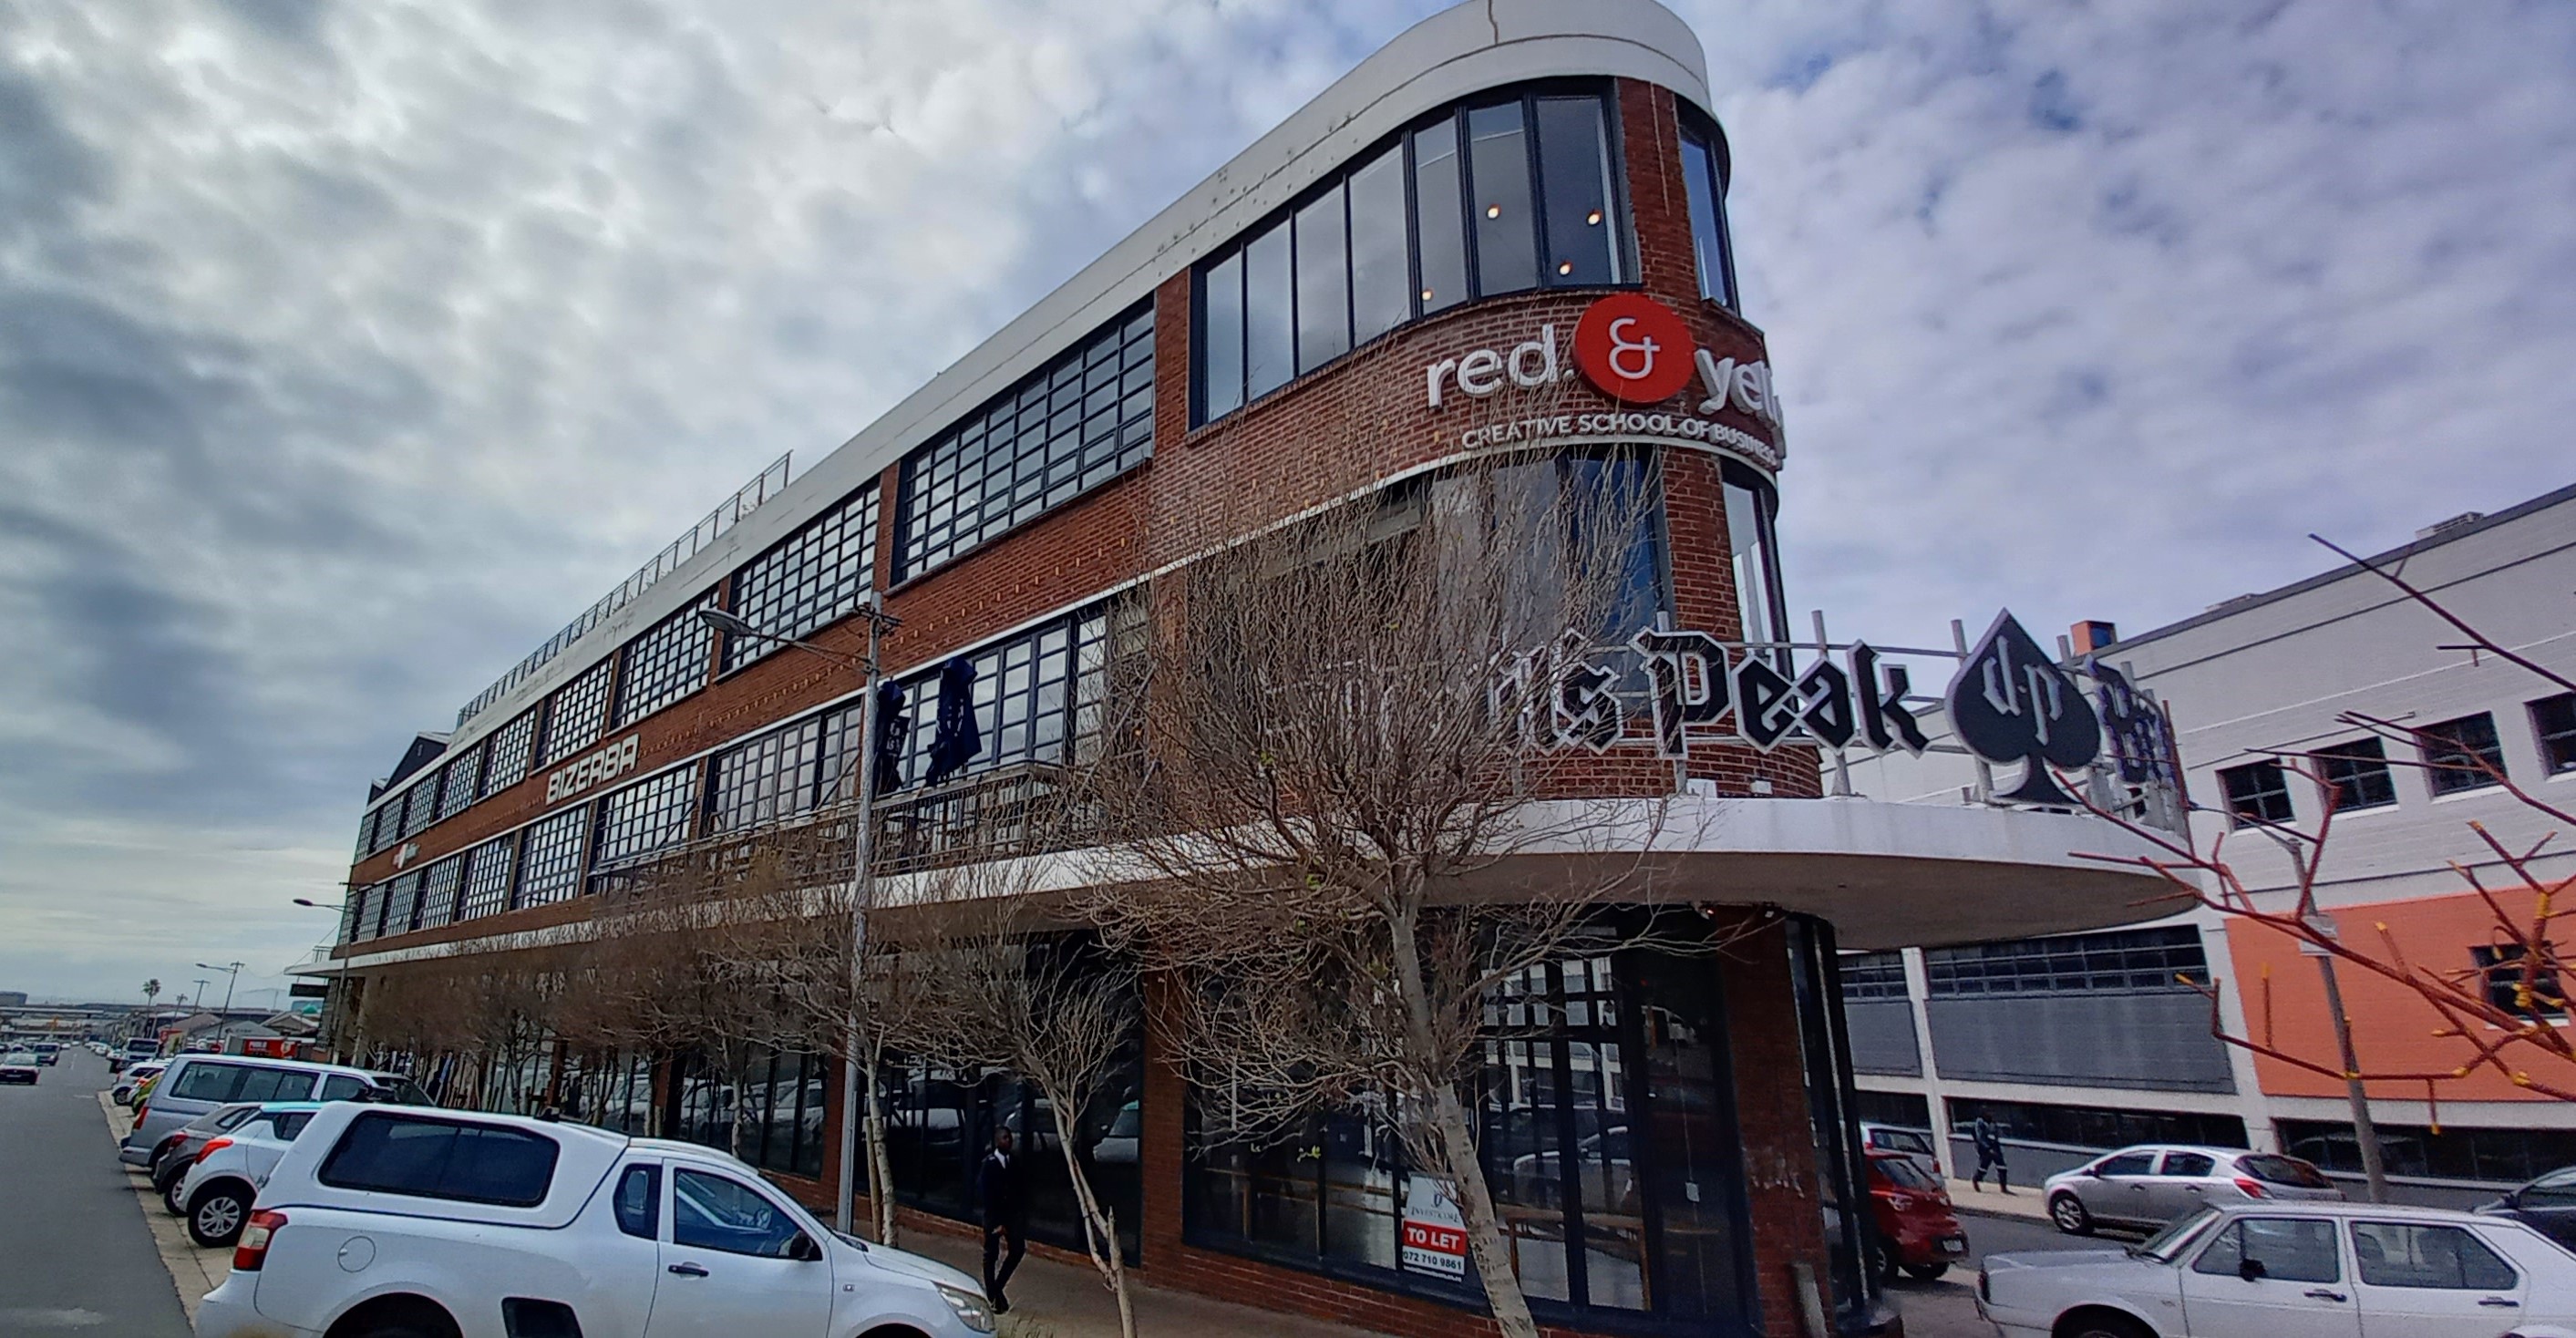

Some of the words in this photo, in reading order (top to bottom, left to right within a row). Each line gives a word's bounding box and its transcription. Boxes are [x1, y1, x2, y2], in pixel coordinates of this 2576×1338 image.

[1609, 316, 1661, 381] &
[1461, 415, 1571, 450] CREATIVE
[1577, 412, 1679, 436] SCHOOL
[1681, 417, 1710, 438] OF
[1626, 626, 1930, 760] Peak
[545, 733, 640, 807] BIZERBA
[1403, 1250, 1419, 1262] 072
[1422, 1252, 1437, 1267] 710
[1440, 1257, 1462, 1271] 9861
[1407, 1226, 1427, 1244] TO
[1430, 1231, 1460, 1250] LET
